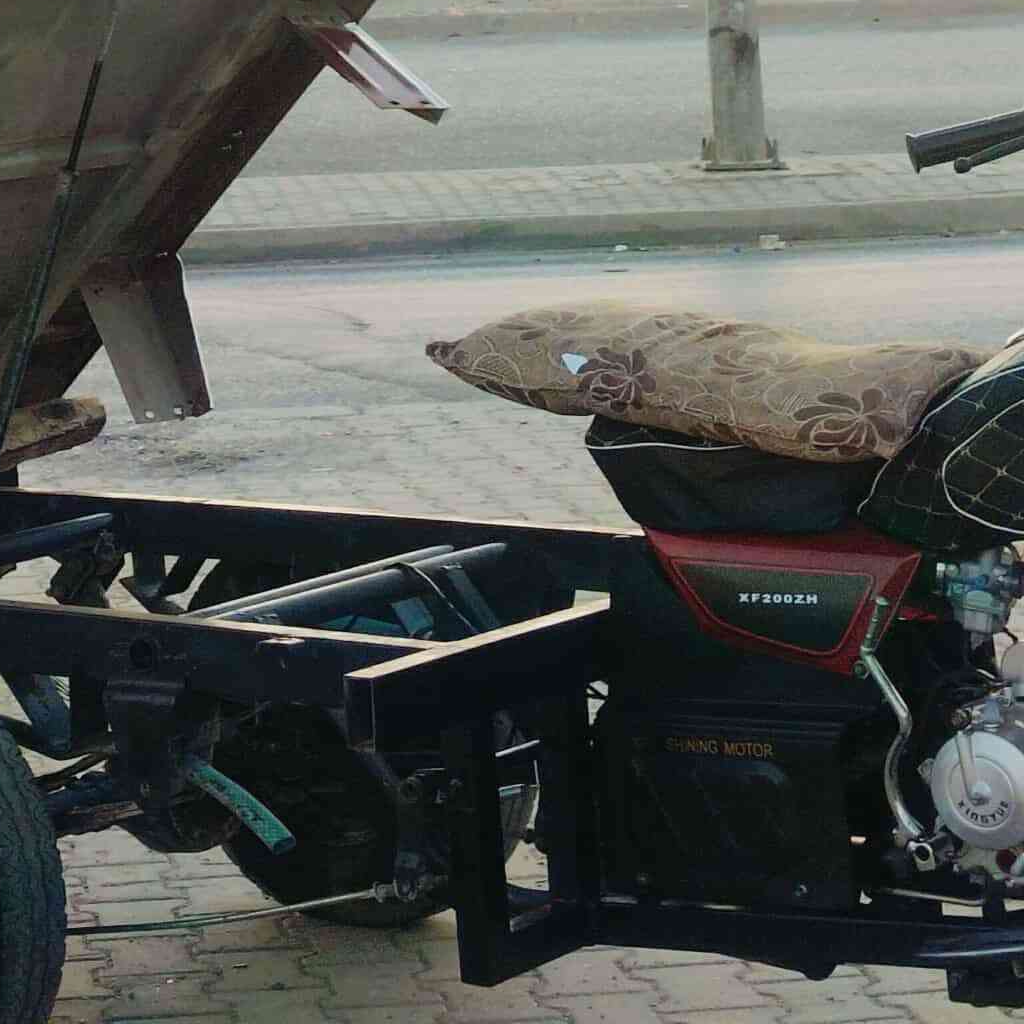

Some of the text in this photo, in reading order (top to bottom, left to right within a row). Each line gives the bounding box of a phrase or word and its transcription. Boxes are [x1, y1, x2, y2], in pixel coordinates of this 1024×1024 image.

[738, 592, 818, 605] XF200ZH
[665, 737, 774, 758] SHINING MOTOR
